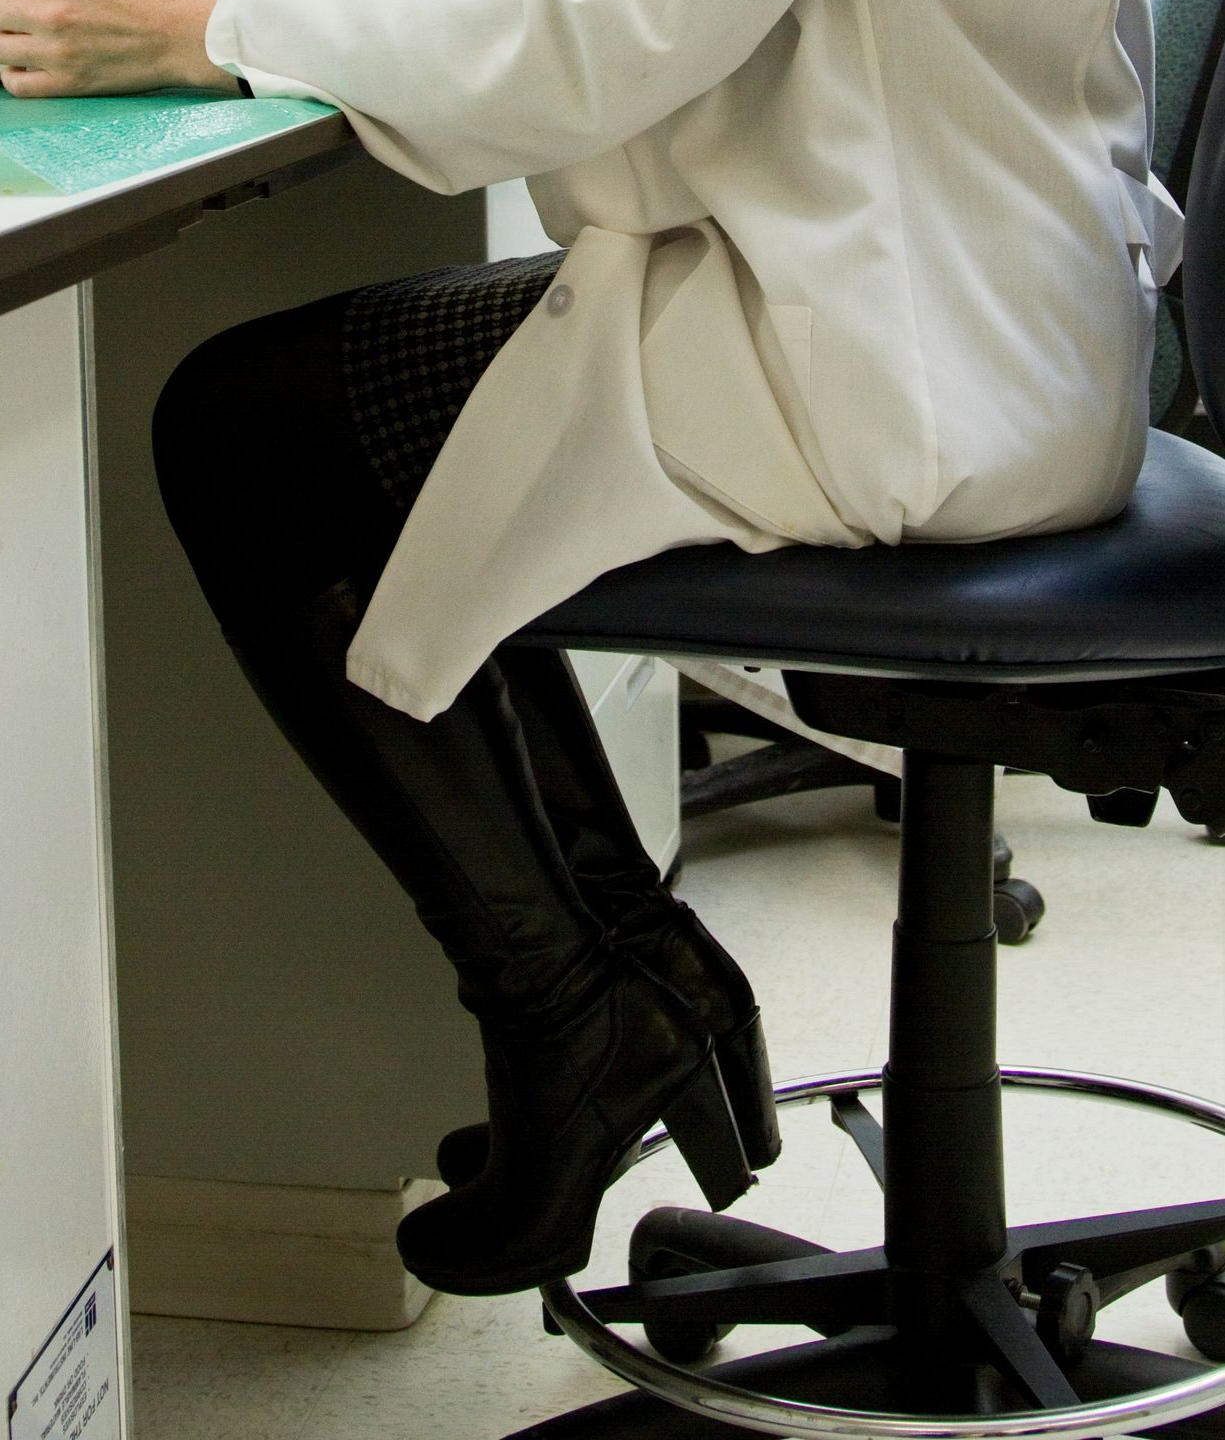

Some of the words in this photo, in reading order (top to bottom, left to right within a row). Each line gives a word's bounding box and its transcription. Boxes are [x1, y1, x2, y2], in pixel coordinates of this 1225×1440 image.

[73, 1355, 86, 1379] FOOD
[97, 1377, 109, 1408] NOT
[82, 1398, 96, 1428] FOR
